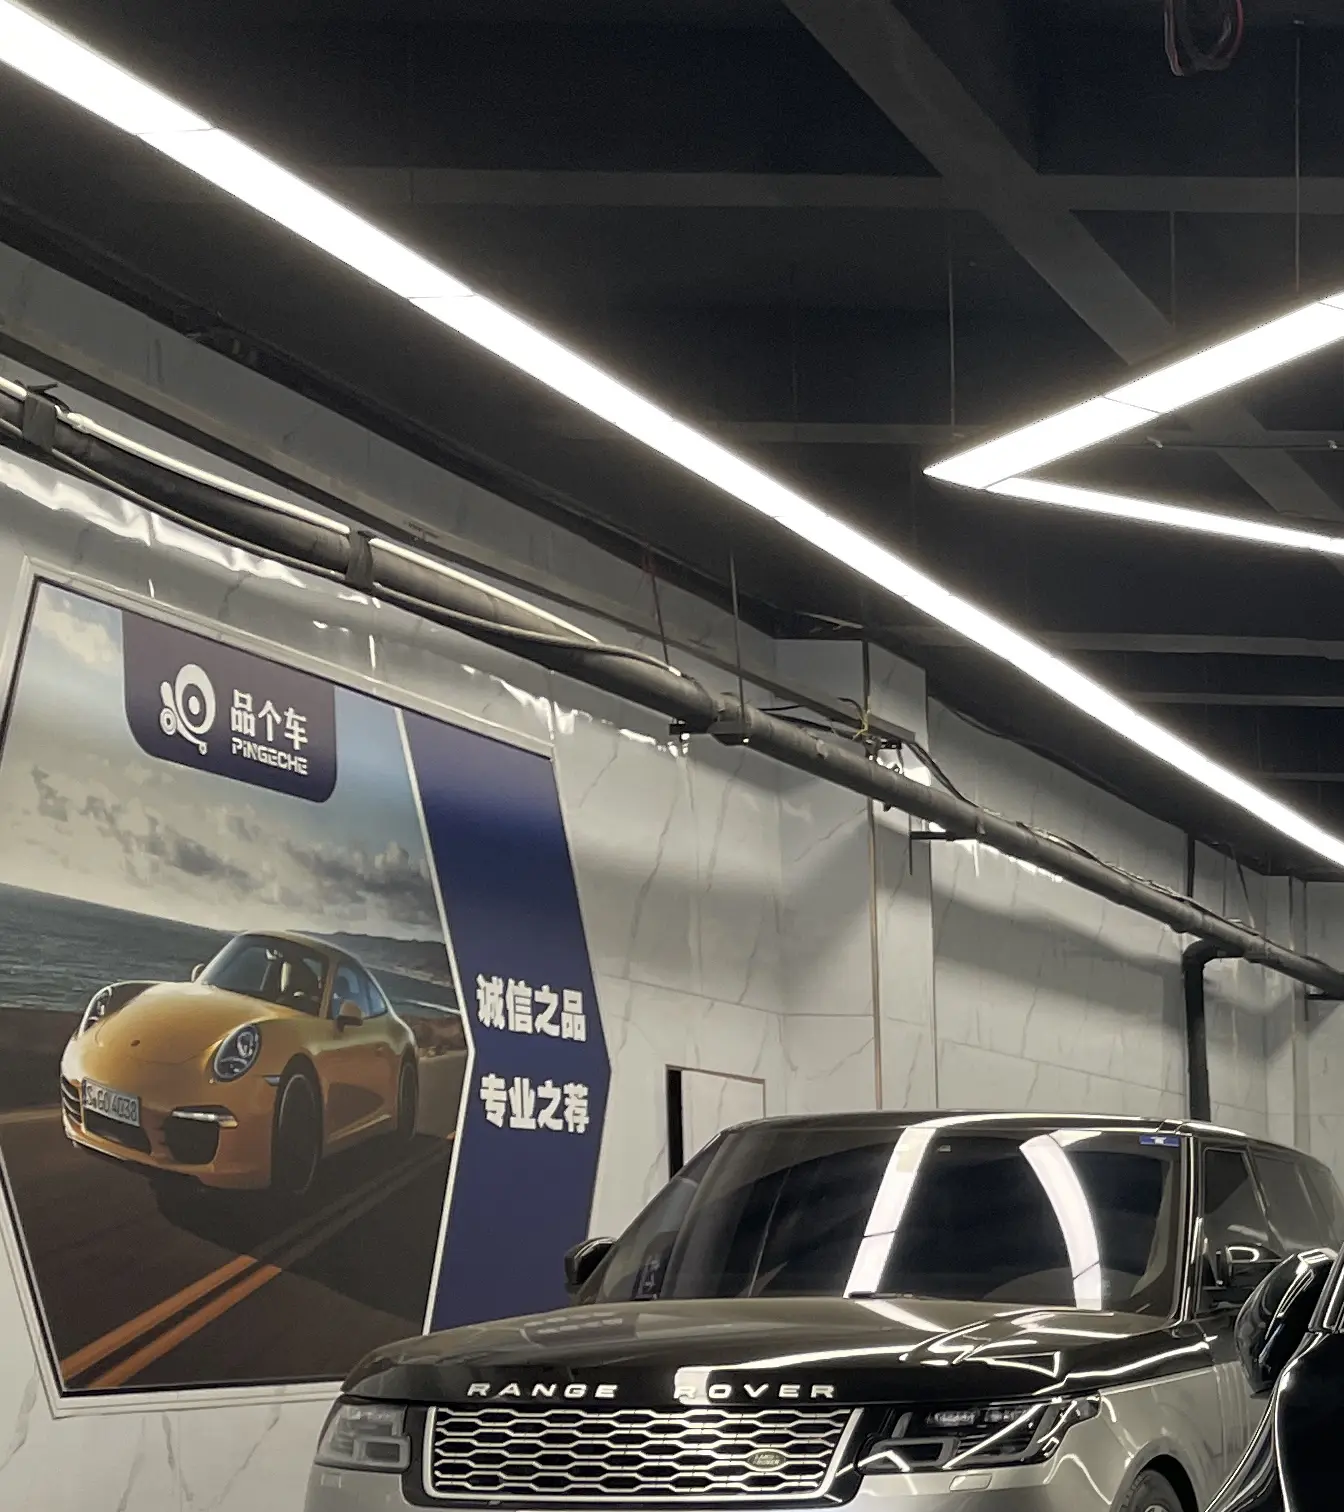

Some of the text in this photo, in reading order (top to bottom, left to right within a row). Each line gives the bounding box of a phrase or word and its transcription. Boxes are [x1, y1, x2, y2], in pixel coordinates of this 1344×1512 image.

[231, 689, 308, 750] 品个车
[476, 973, 587, 1042] 诚信之品
[480, 1073, 590, 1134] 专业之荐
[467, 1383, 835, 1400] RANGE ROVER
